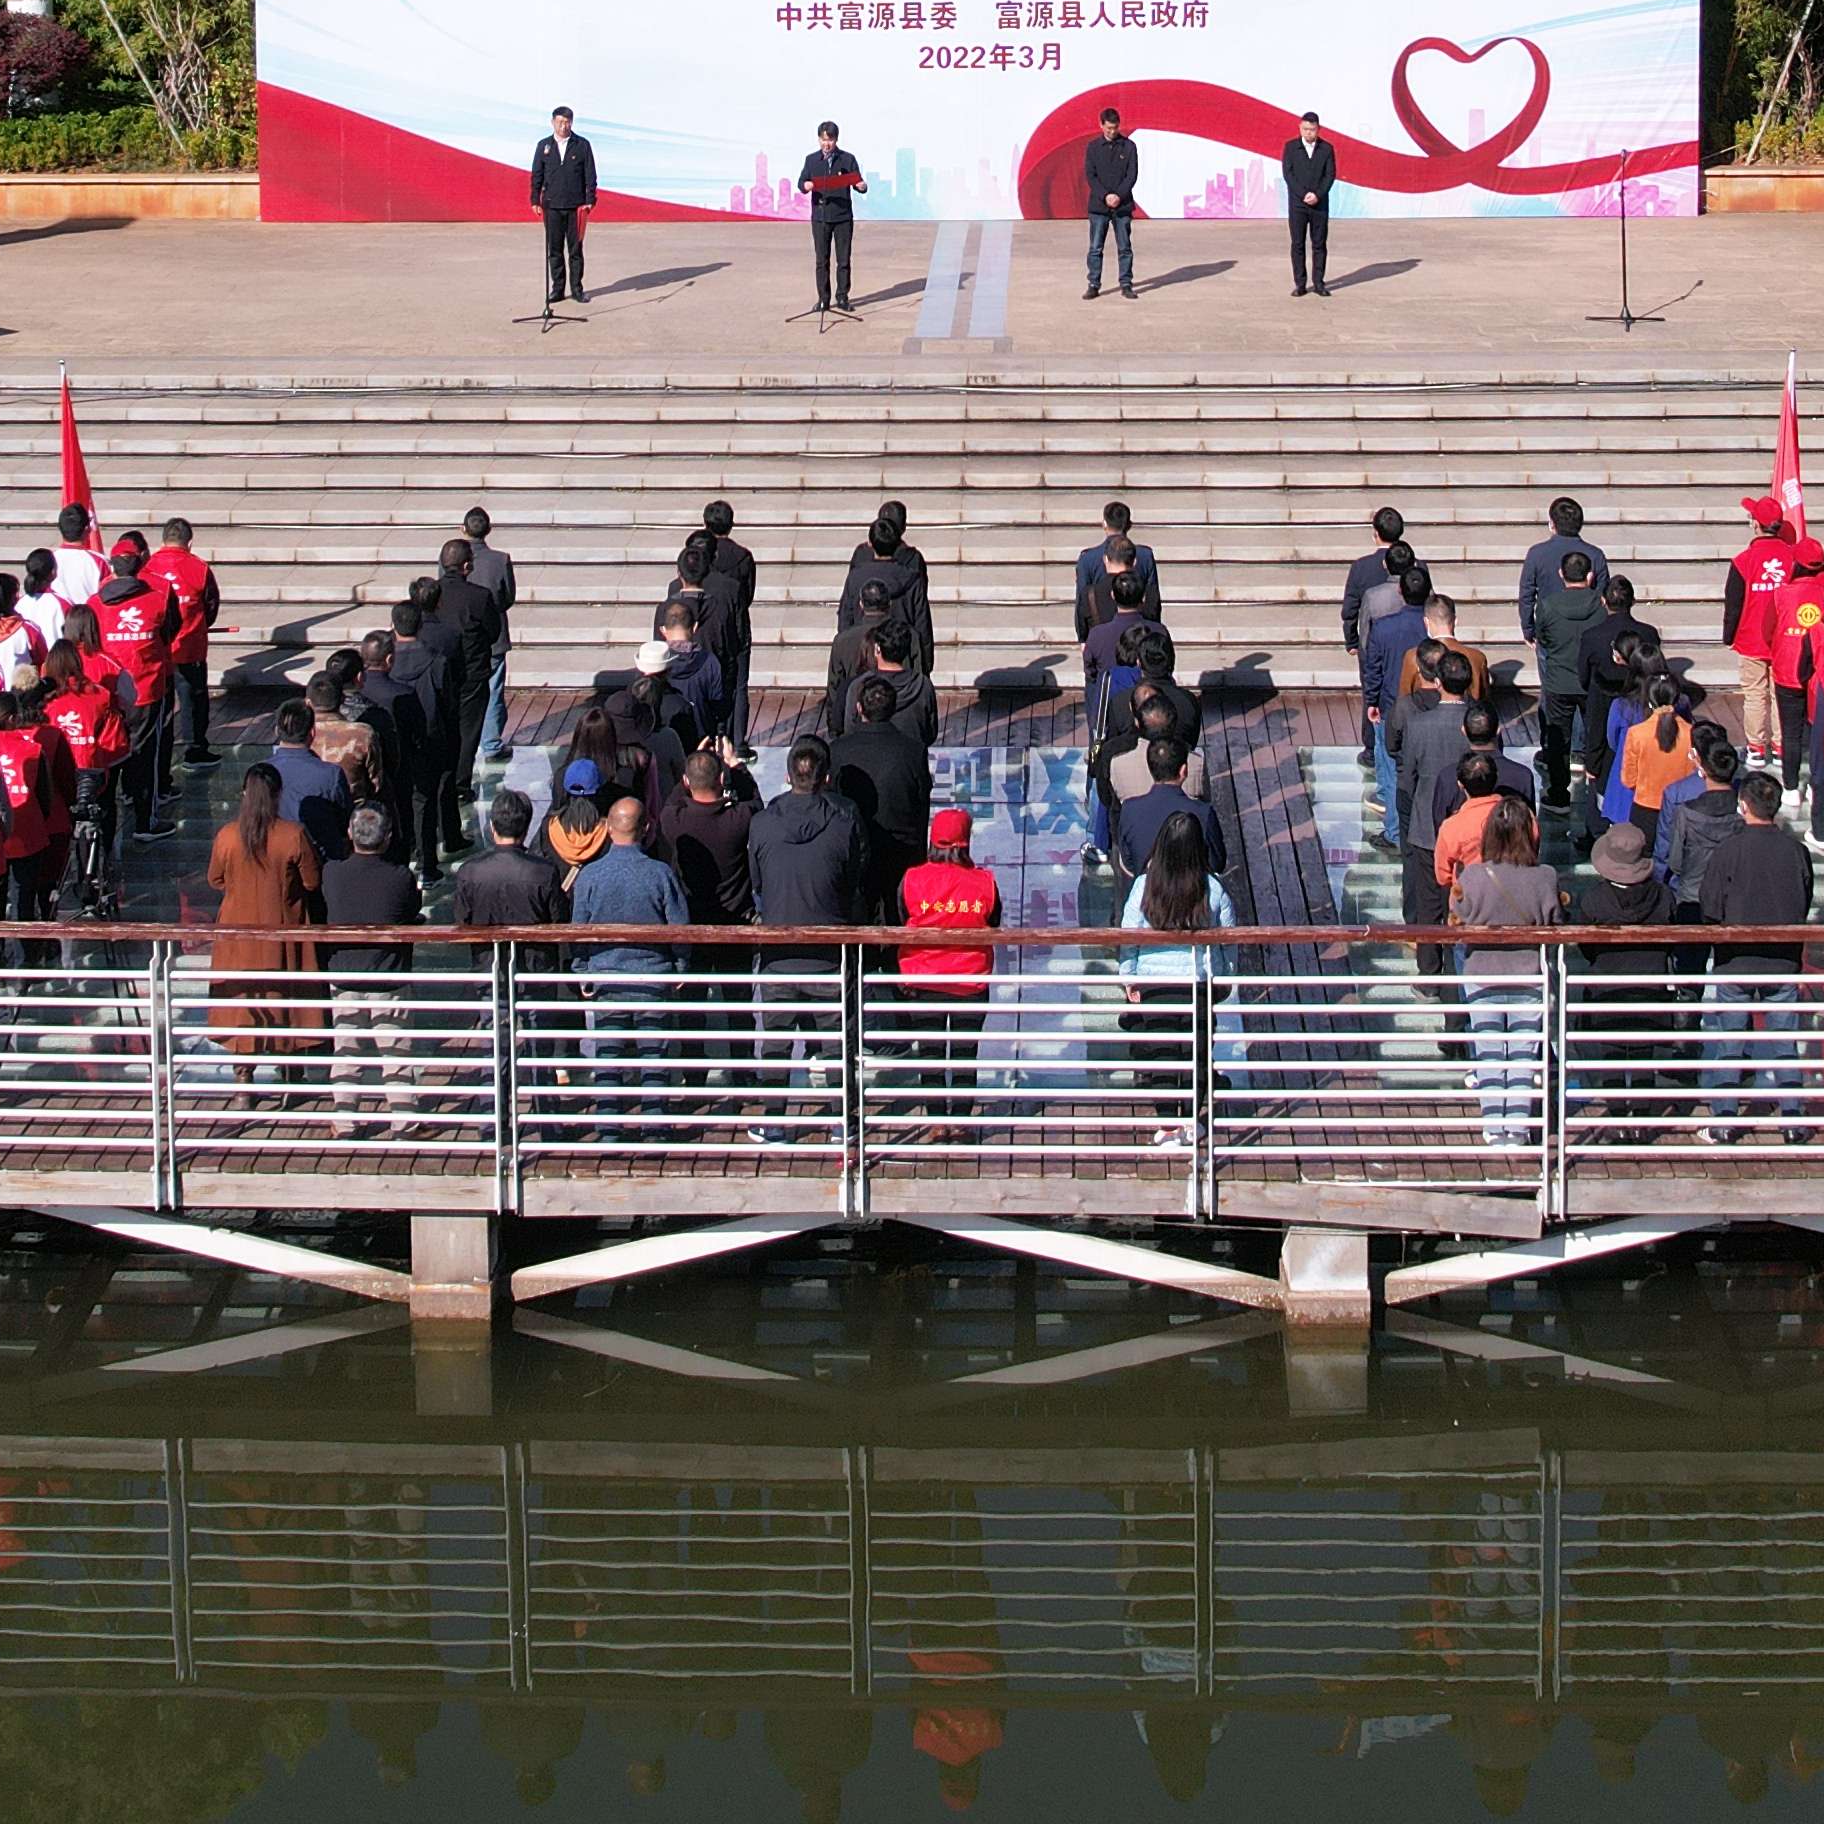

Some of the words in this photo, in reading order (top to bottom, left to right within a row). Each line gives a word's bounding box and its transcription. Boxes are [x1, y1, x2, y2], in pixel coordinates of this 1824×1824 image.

[776, 0, 958, 33] 中共富源县委
[918, 42, 1063, 72] 2022年3月
